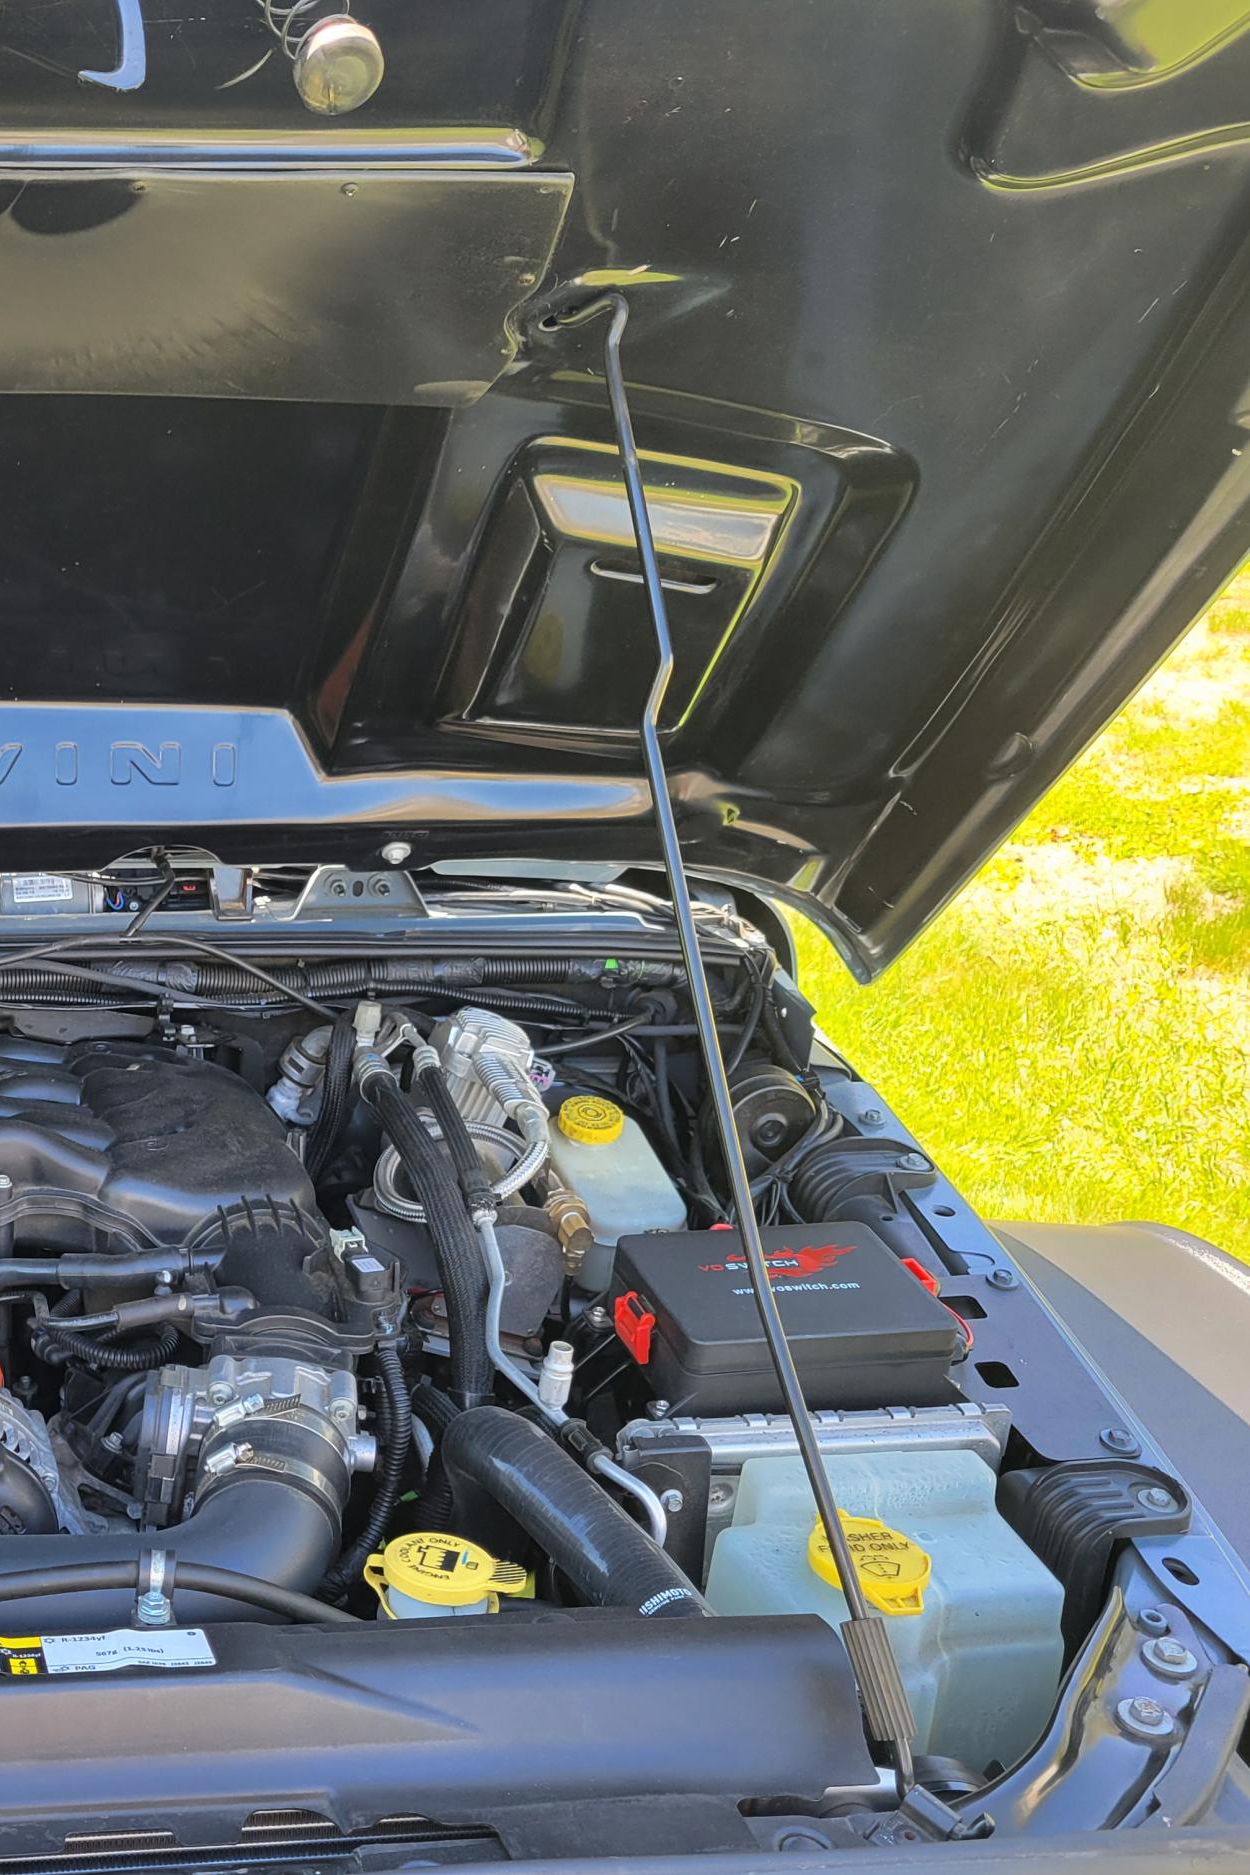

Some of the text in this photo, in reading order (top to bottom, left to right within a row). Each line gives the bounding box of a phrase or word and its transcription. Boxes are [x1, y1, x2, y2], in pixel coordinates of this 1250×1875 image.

[399, 1537, 426, 1563] COOLANT
[428, 1537, 461, 1548] ONLY
[817, 1541, 910, 1553] FID ONLY
[638, 1587, 693, 1616] ISHIMOTO
[61, 1635, 106, 1644] R-1234yf
[74, 1664, 97, 1672] PAG
